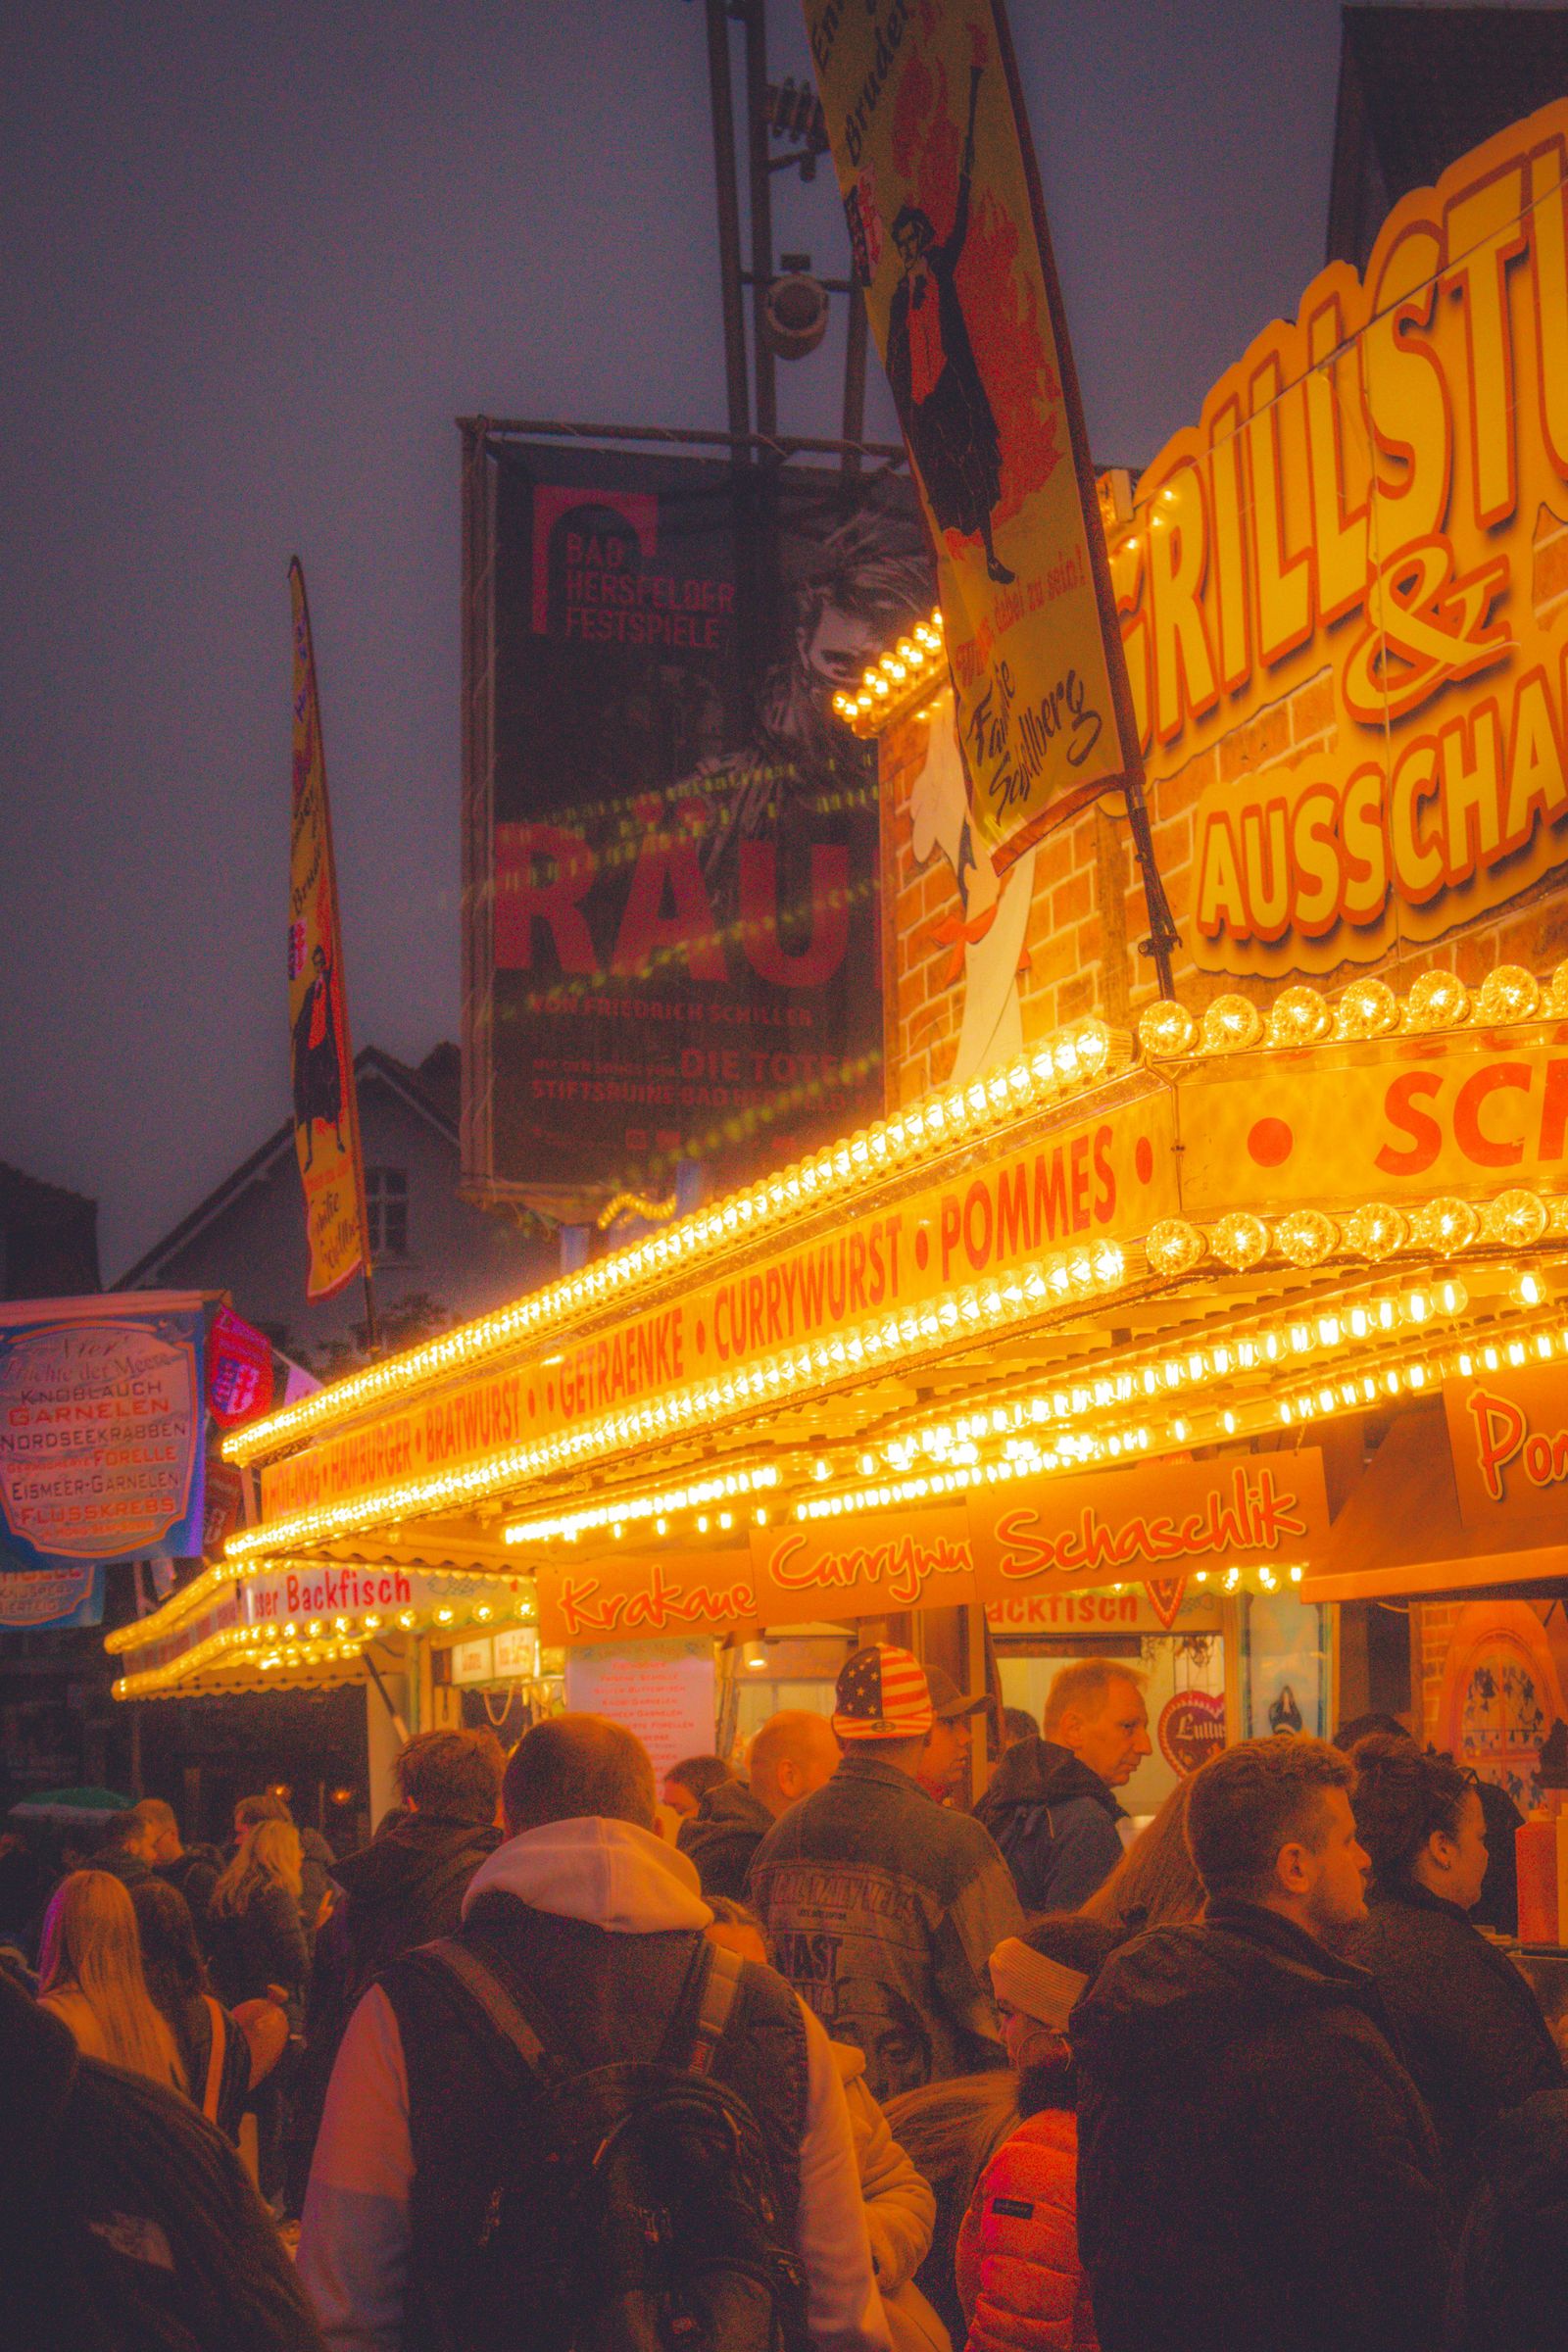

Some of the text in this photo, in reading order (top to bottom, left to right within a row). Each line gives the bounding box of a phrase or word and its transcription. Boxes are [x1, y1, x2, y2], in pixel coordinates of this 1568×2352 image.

[566, 533, 624, 568] BAD
[566, 571, 735, 614] HERSFELDER
[565, 607, 719, 649] FESTSPIELE
[1342, 534, 1510, 725] &
[1197, 640, 1568, 943] AUSSCHA
[585, 995, 704, 1021] FRIEDRICH
[710, 1002, 812, 1027] SCHILLER
[681, 1048, 739, 1079] DIE
[749, 1051, 857, 1084] TOTE
[681, 1086, 728, 1107] BAD
[425, 1383, 521, 1464] BRATWURST
[559, 1307, 684, 1418] GETRAENKE
[713, 1213, 902, 1361] CURRYWURST
[941, 1124, 1117, 1281] POMMES
[21, 1380, 162, 1404] KNOBLAUCH
[8, 1398, 170, 1427] GARNELEN
[0, 1422, 186, 1451] NORDSEEKRABBEN
[94, 1446, 176, 1468] FORELLE
[21, 1496, 175, 1526] FLUSSKREBS
[994, 1466, 1306, 1580] Schaschlik
[286, 1570, 412, 1613] Backfisch
